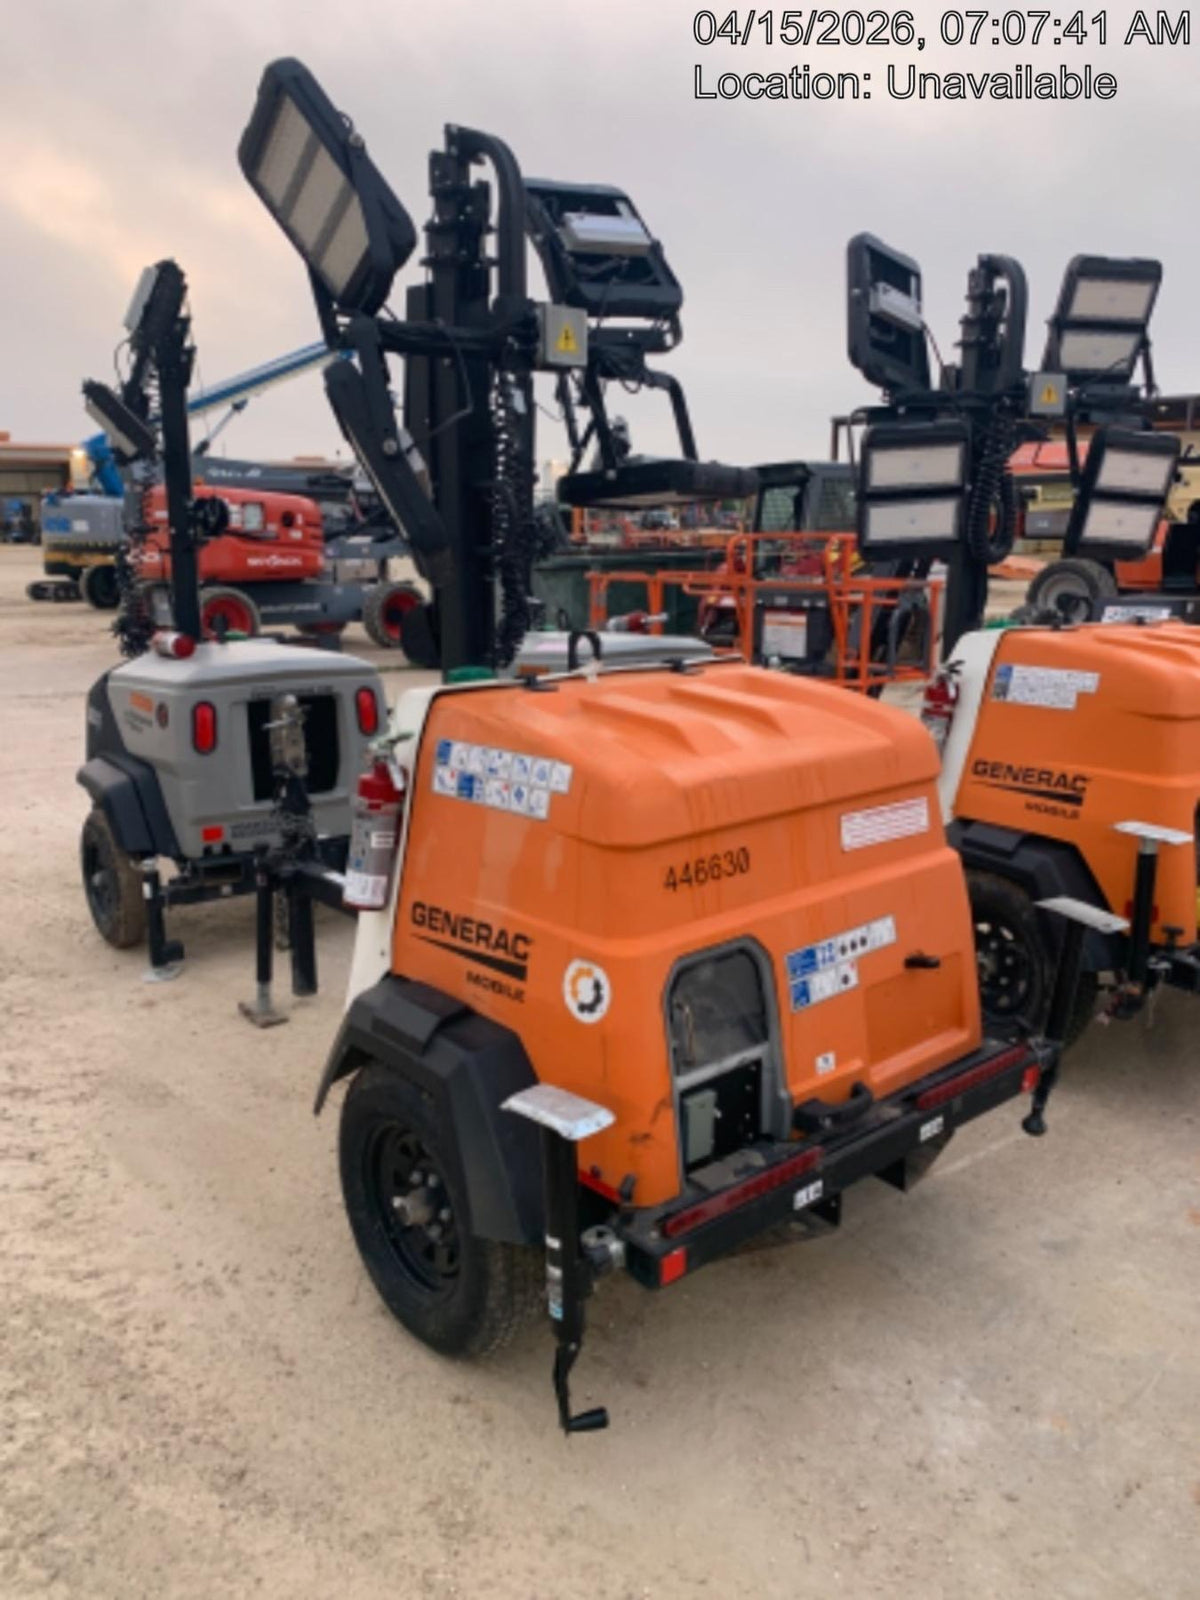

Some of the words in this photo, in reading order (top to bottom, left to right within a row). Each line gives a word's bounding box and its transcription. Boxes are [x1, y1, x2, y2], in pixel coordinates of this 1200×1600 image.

[971, 759, 1090, 794] GENERAC
[663, 846, 750, 892] 446630
[411, 901, 532, 962] GENERAC
[465, 971, 526, 1004] MOBILE
